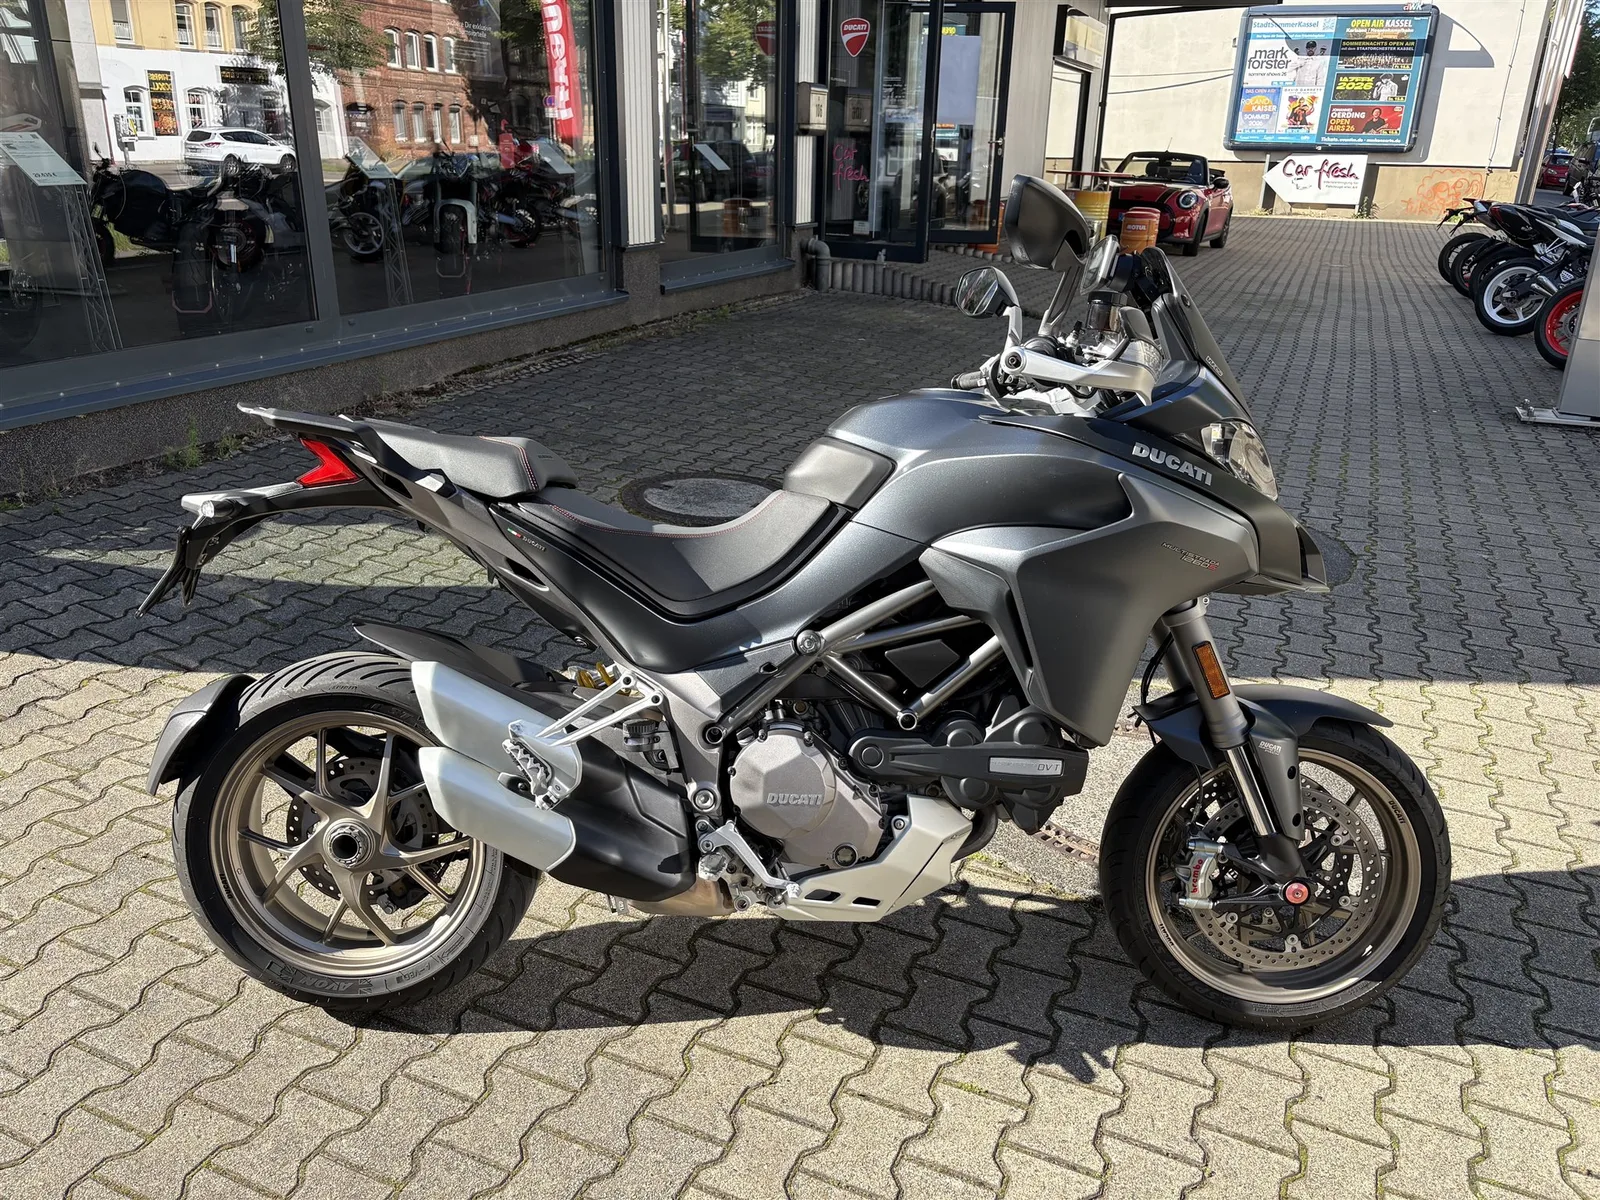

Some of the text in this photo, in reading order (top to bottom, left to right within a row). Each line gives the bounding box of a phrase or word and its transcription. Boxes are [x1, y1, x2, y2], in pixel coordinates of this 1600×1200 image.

[1351, 19, 1413, 28] OPEN AIR KASSEL
[1252, 47, 1288, 60] mark
[1248, 57, 1291, 70] forster
[1336, 82, 1374, 90] 2026
[815, 104, 823, 118] 106
[833, 144, 858, 161] Car
[833, 165, 869, 190] fresh
[1283, 158, 1359, 190] Car fresh
[1132, 442, 1213, 486] DUCATI
[522, 535, 546, 551] DUCATI
[1161, 542, 1220, 566] MULTISTRADA
[1180, 555, 1219, 572] 1260S
[1259, 741, 1282, 752] DUCATI
[1037, 763, 1060, 771] DVT
[766, 792, 823, 806] DUCATI
[1388, 801, 1406, 824] DUCATI
[1191, 859, 1204, 894] brembo
[219, 873, 233, 899] DUCATI
[300, 975, 352, 992] AVON
